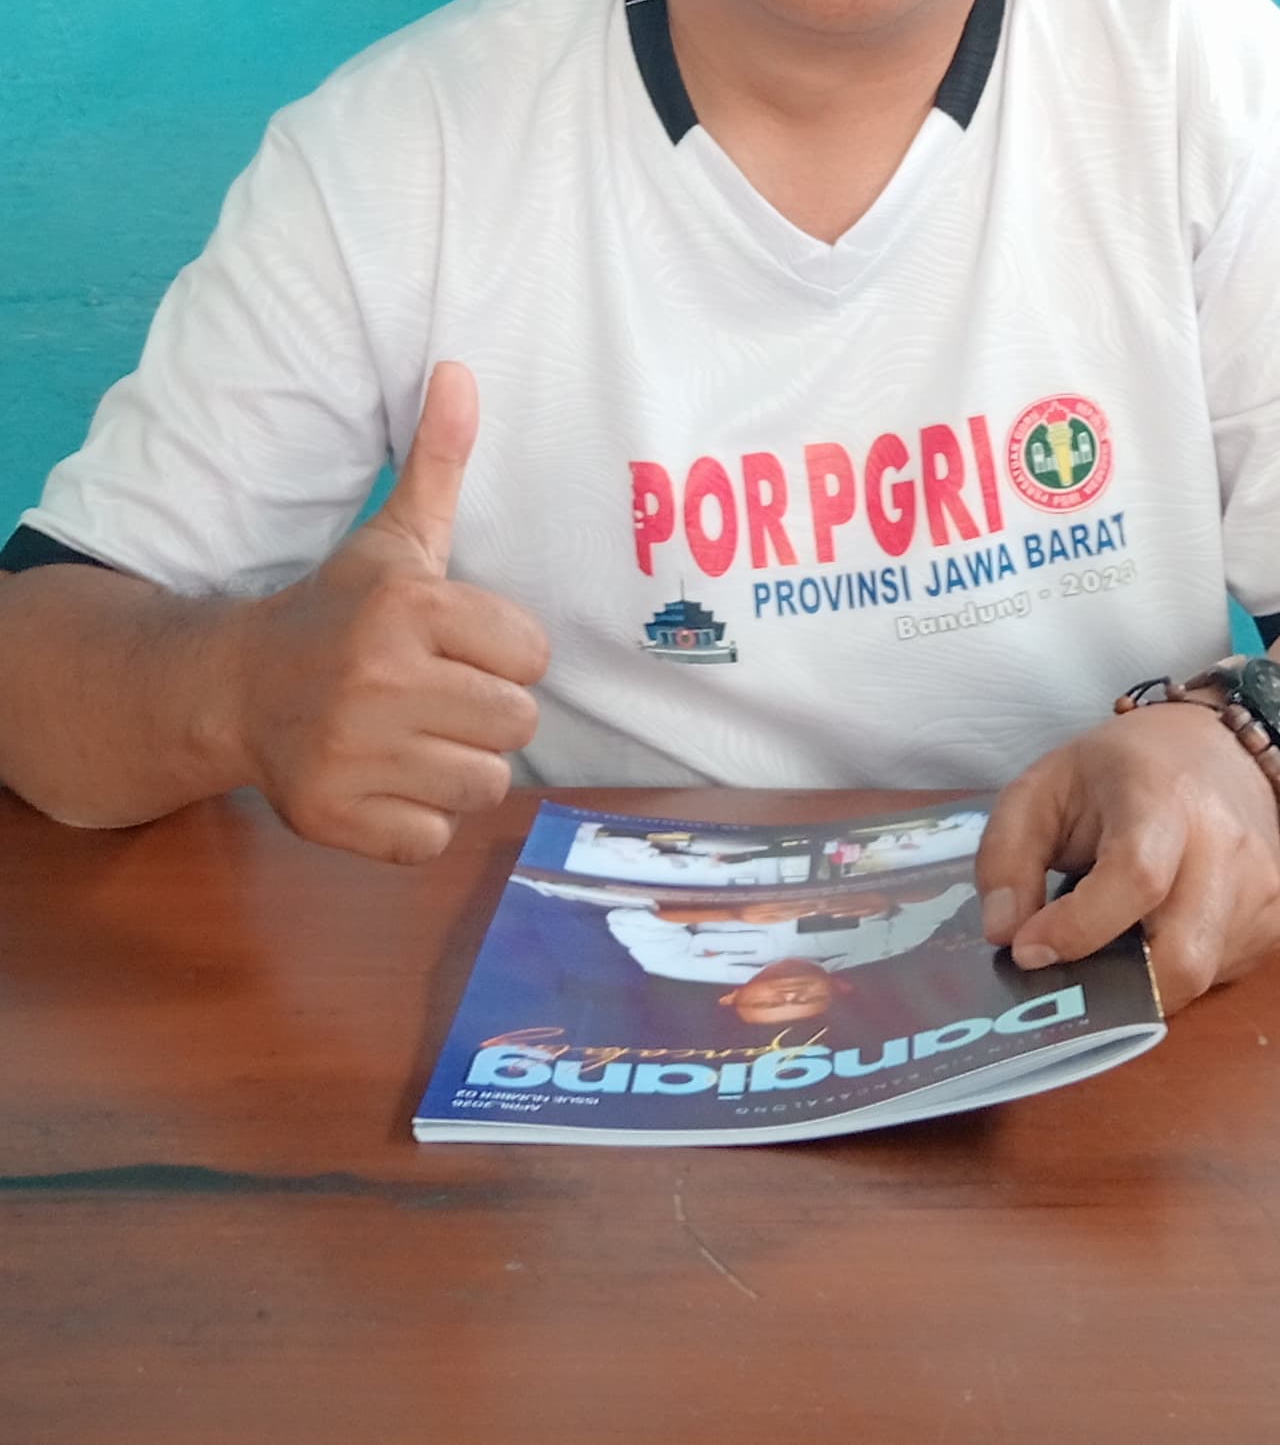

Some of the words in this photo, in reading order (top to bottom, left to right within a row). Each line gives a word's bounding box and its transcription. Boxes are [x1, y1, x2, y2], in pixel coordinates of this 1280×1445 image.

[628, 452, 799, 577] POR
[804, 415, 1004, 564] PGRI
[754, 565, 911, 618] PROVINSI
[925, 543, 1018, 597] JAWA
[1024, 512, 1128, 569] BARAT
[895, 590, 1031, 640] Bandung
[465, 984, 1086, 1101] Dangiang
